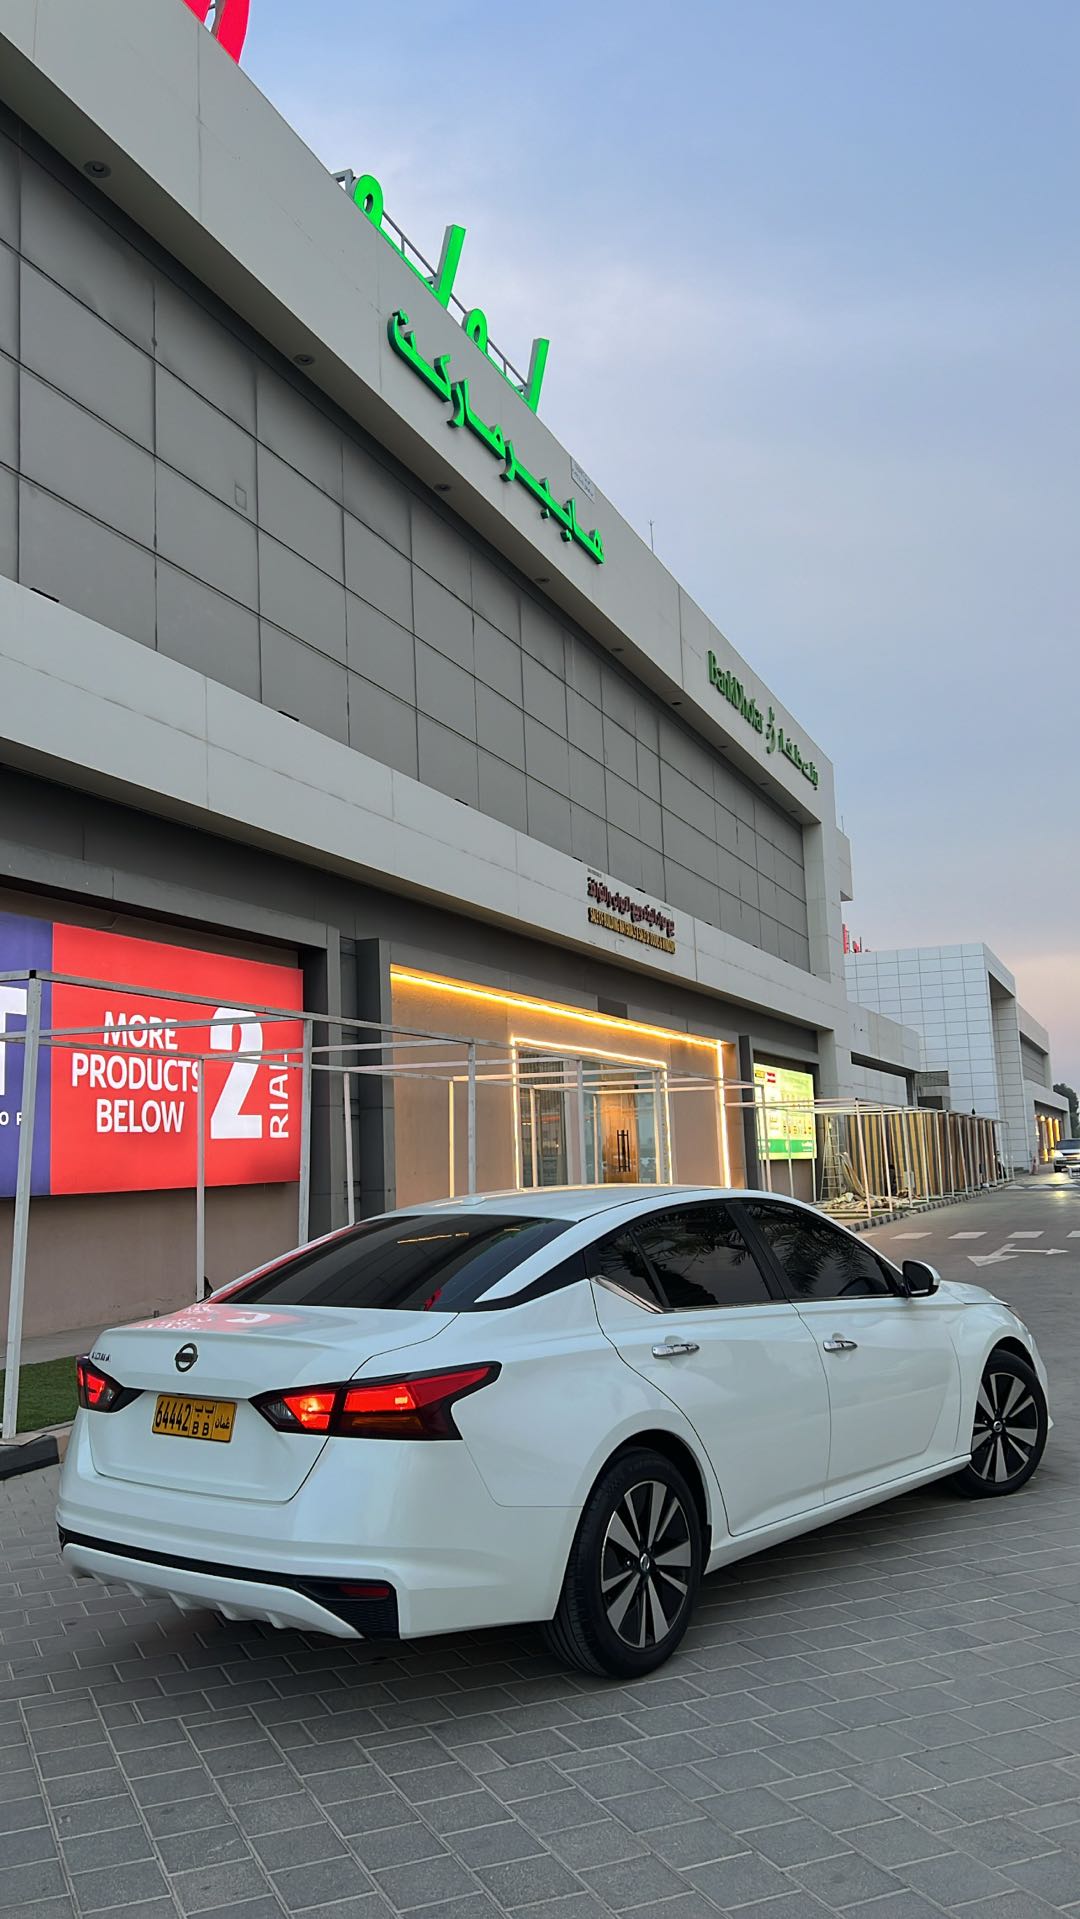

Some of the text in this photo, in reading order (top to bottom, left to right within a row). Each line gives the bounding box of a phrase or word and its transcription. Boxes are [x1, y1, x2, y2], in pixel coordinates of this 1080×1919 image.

[103, 1011, 179, 1050] MORE
[210, 1007, 263, 1139] 2
[96, 1098, 185, 1133] BELOW
[155, 1400, 192, 1431] 64442
